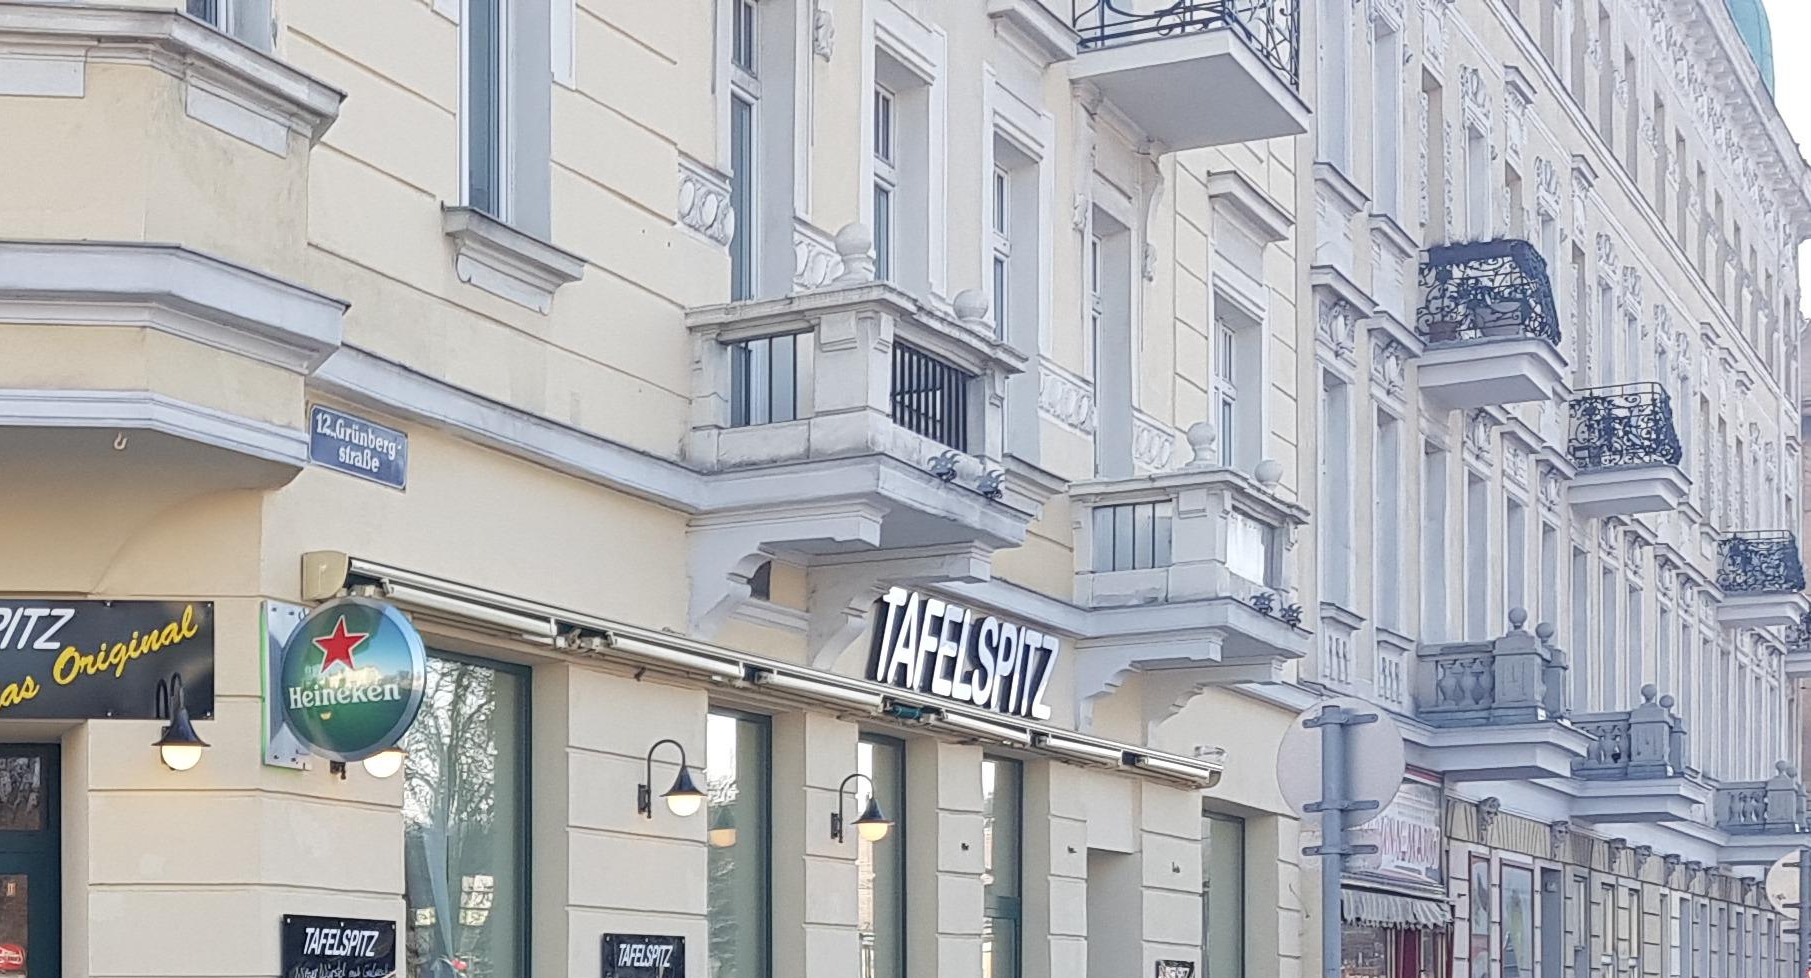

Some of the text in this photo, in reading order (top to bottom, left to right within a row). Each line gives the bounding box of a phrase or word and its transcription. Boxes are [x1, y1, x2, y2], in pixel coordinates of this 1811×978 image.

[338, 445, 380, 472] straße
[52, 604, 199, 686] Original
[865, 585, 1061, 721] TAFELSPITZ
[289, 681, 402, 710] Heineken
[302, 927, 380, 957] TAFELSPITZ
[617, 943, 674, 968] TAFELSPITZ
